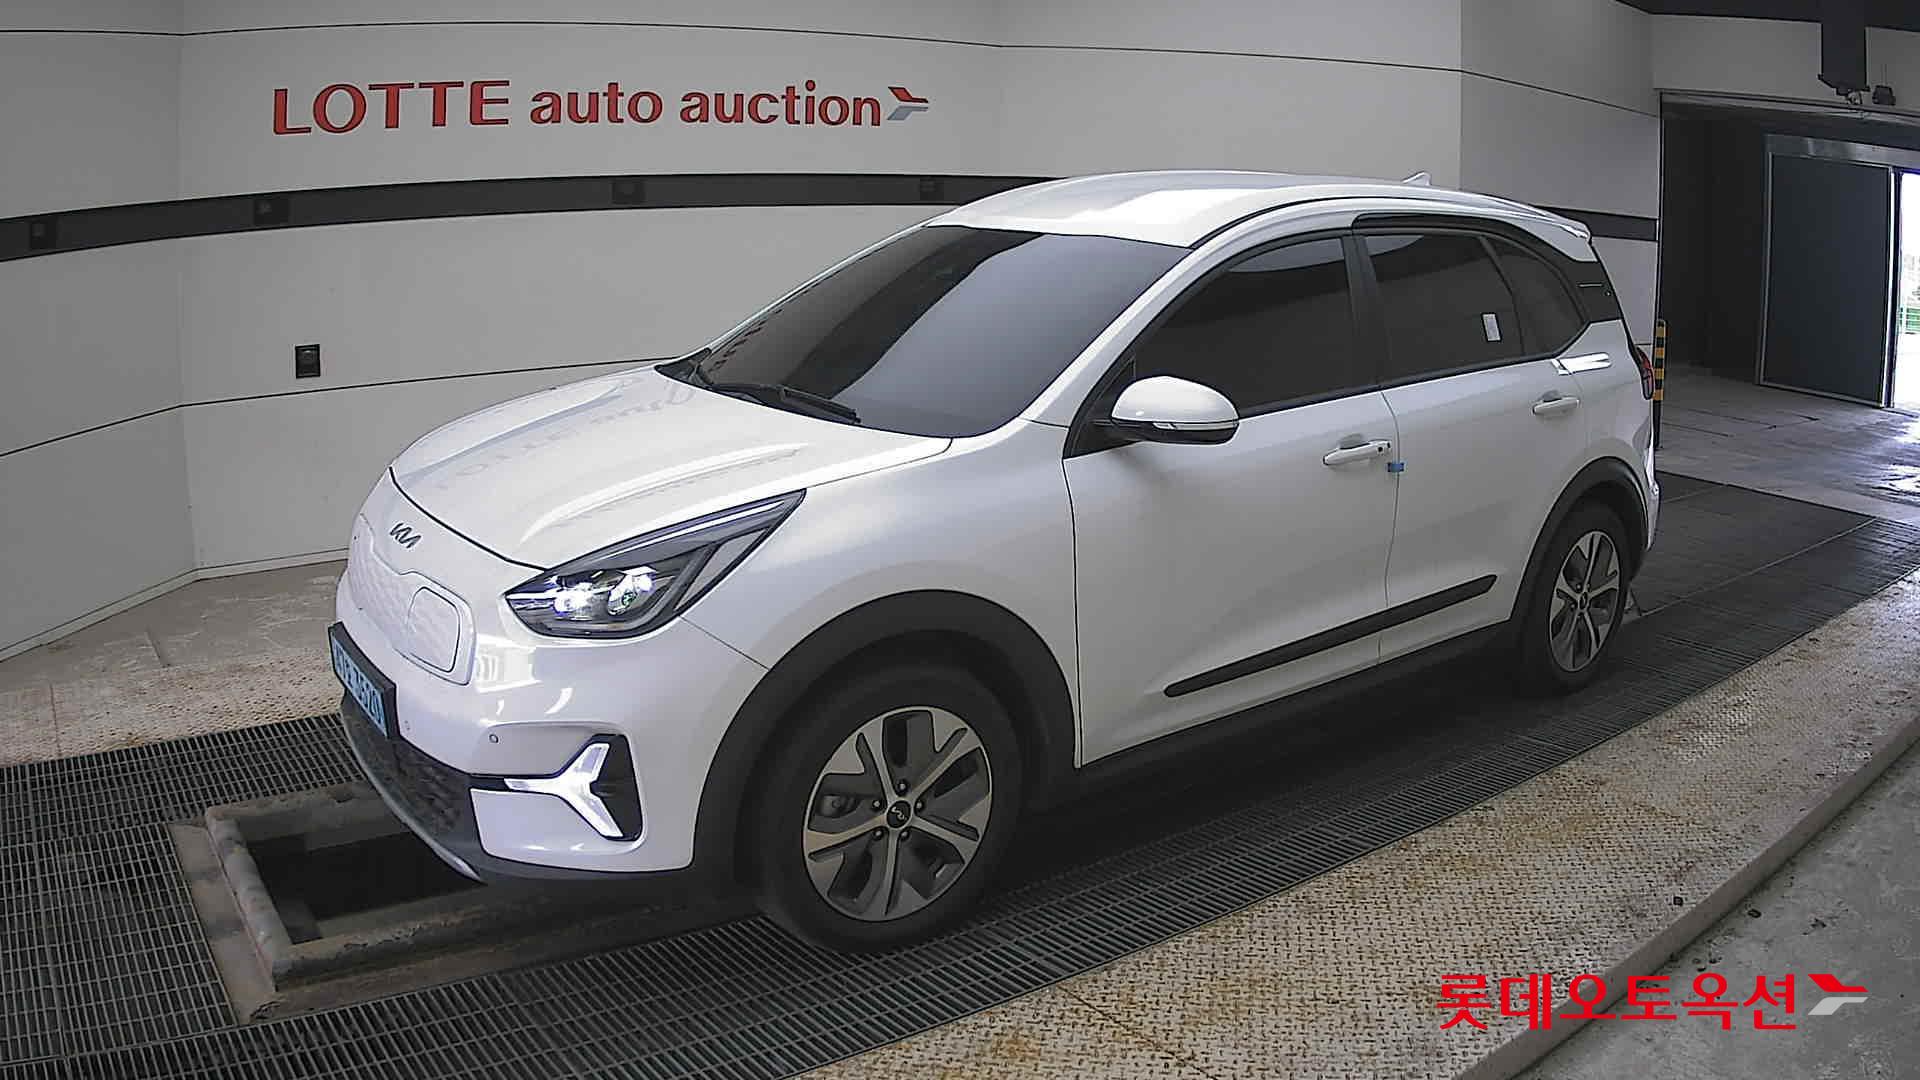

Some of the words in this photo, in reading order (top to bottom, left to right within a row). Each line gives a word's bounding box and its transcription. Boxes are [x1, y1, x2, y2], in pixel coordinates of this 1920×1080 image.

[273, 80, 508, 135] LOTTE
[530, 83, 664, 125] auto
[681, 79, 881, 127] auction
